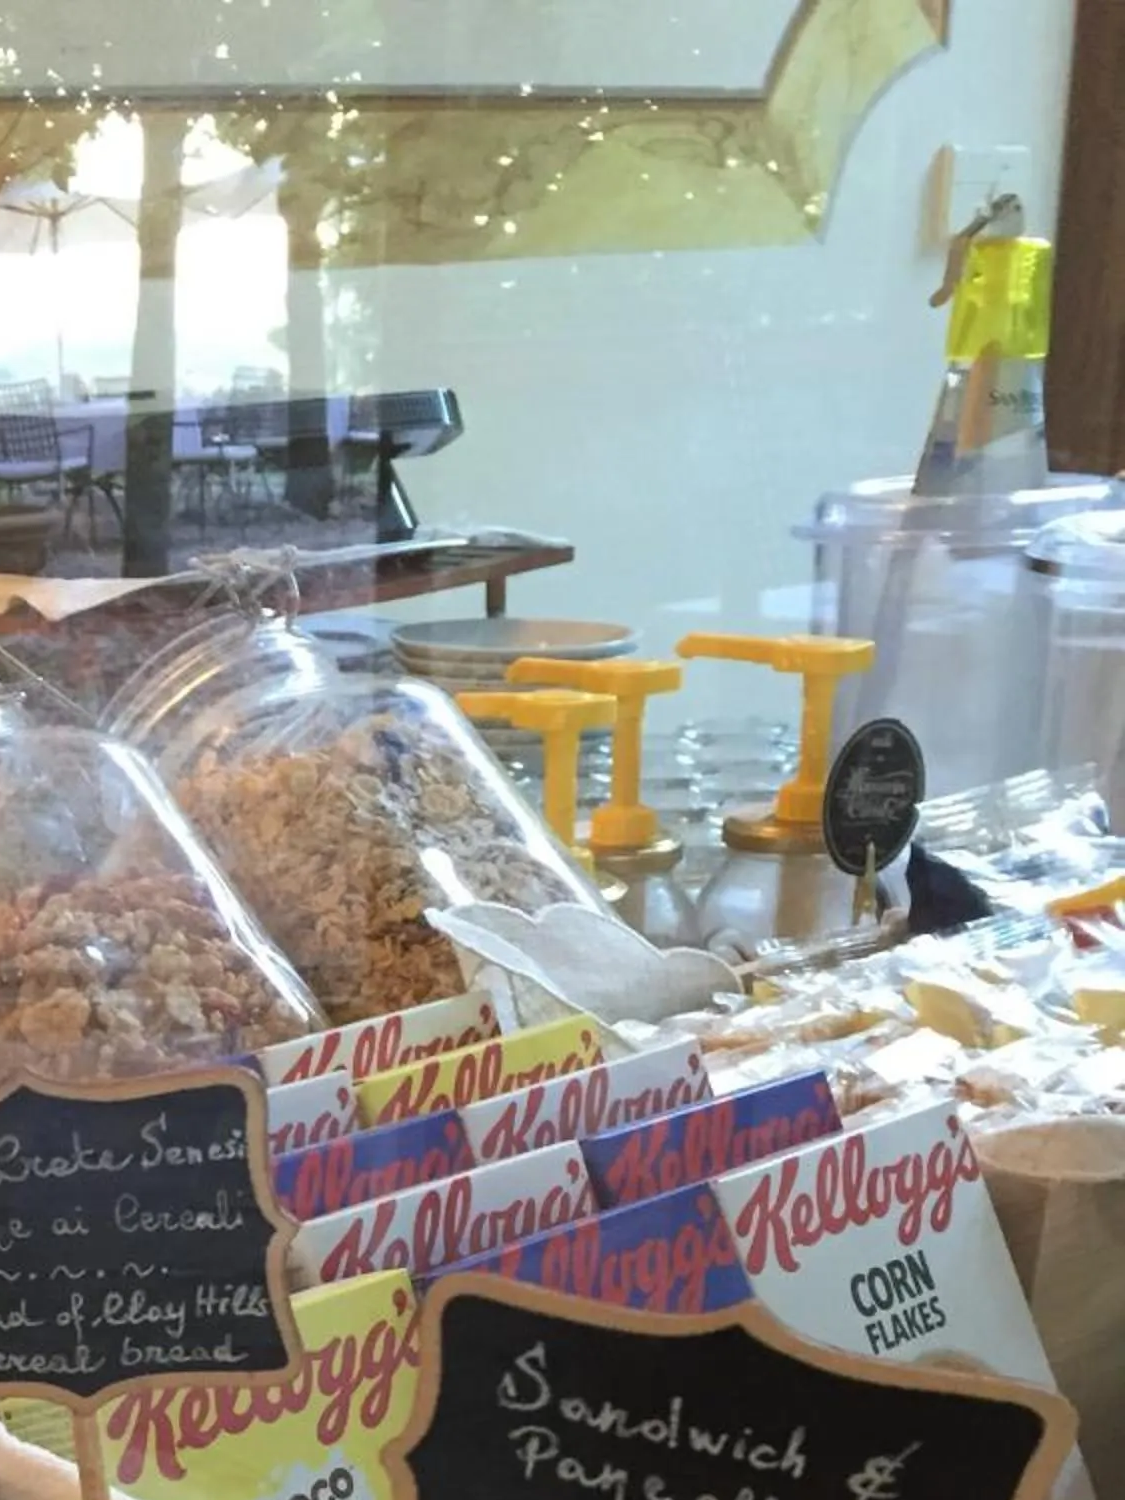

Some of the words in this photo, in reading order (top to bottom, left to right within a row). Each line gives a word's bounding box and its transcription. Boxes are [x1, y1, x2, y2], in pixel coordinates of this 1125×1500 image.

[51, 1207, 90, 1236] ai
[114, 1191, 244, 1233] Cereali
[735, 1114, 980, 1275] Kellogg's
[849, 1249, 937, 1317] CORN
[56, 1292, 85, 1343] of
[91, 1289, 187, 1339] Clay
[195, 1284, 270, 1319] Hills
[864, 1295, 947, 1355] FLAKES
[119, 1333, 250, 1367] bread
[497, 1341, 808, 1480] Sandwich
